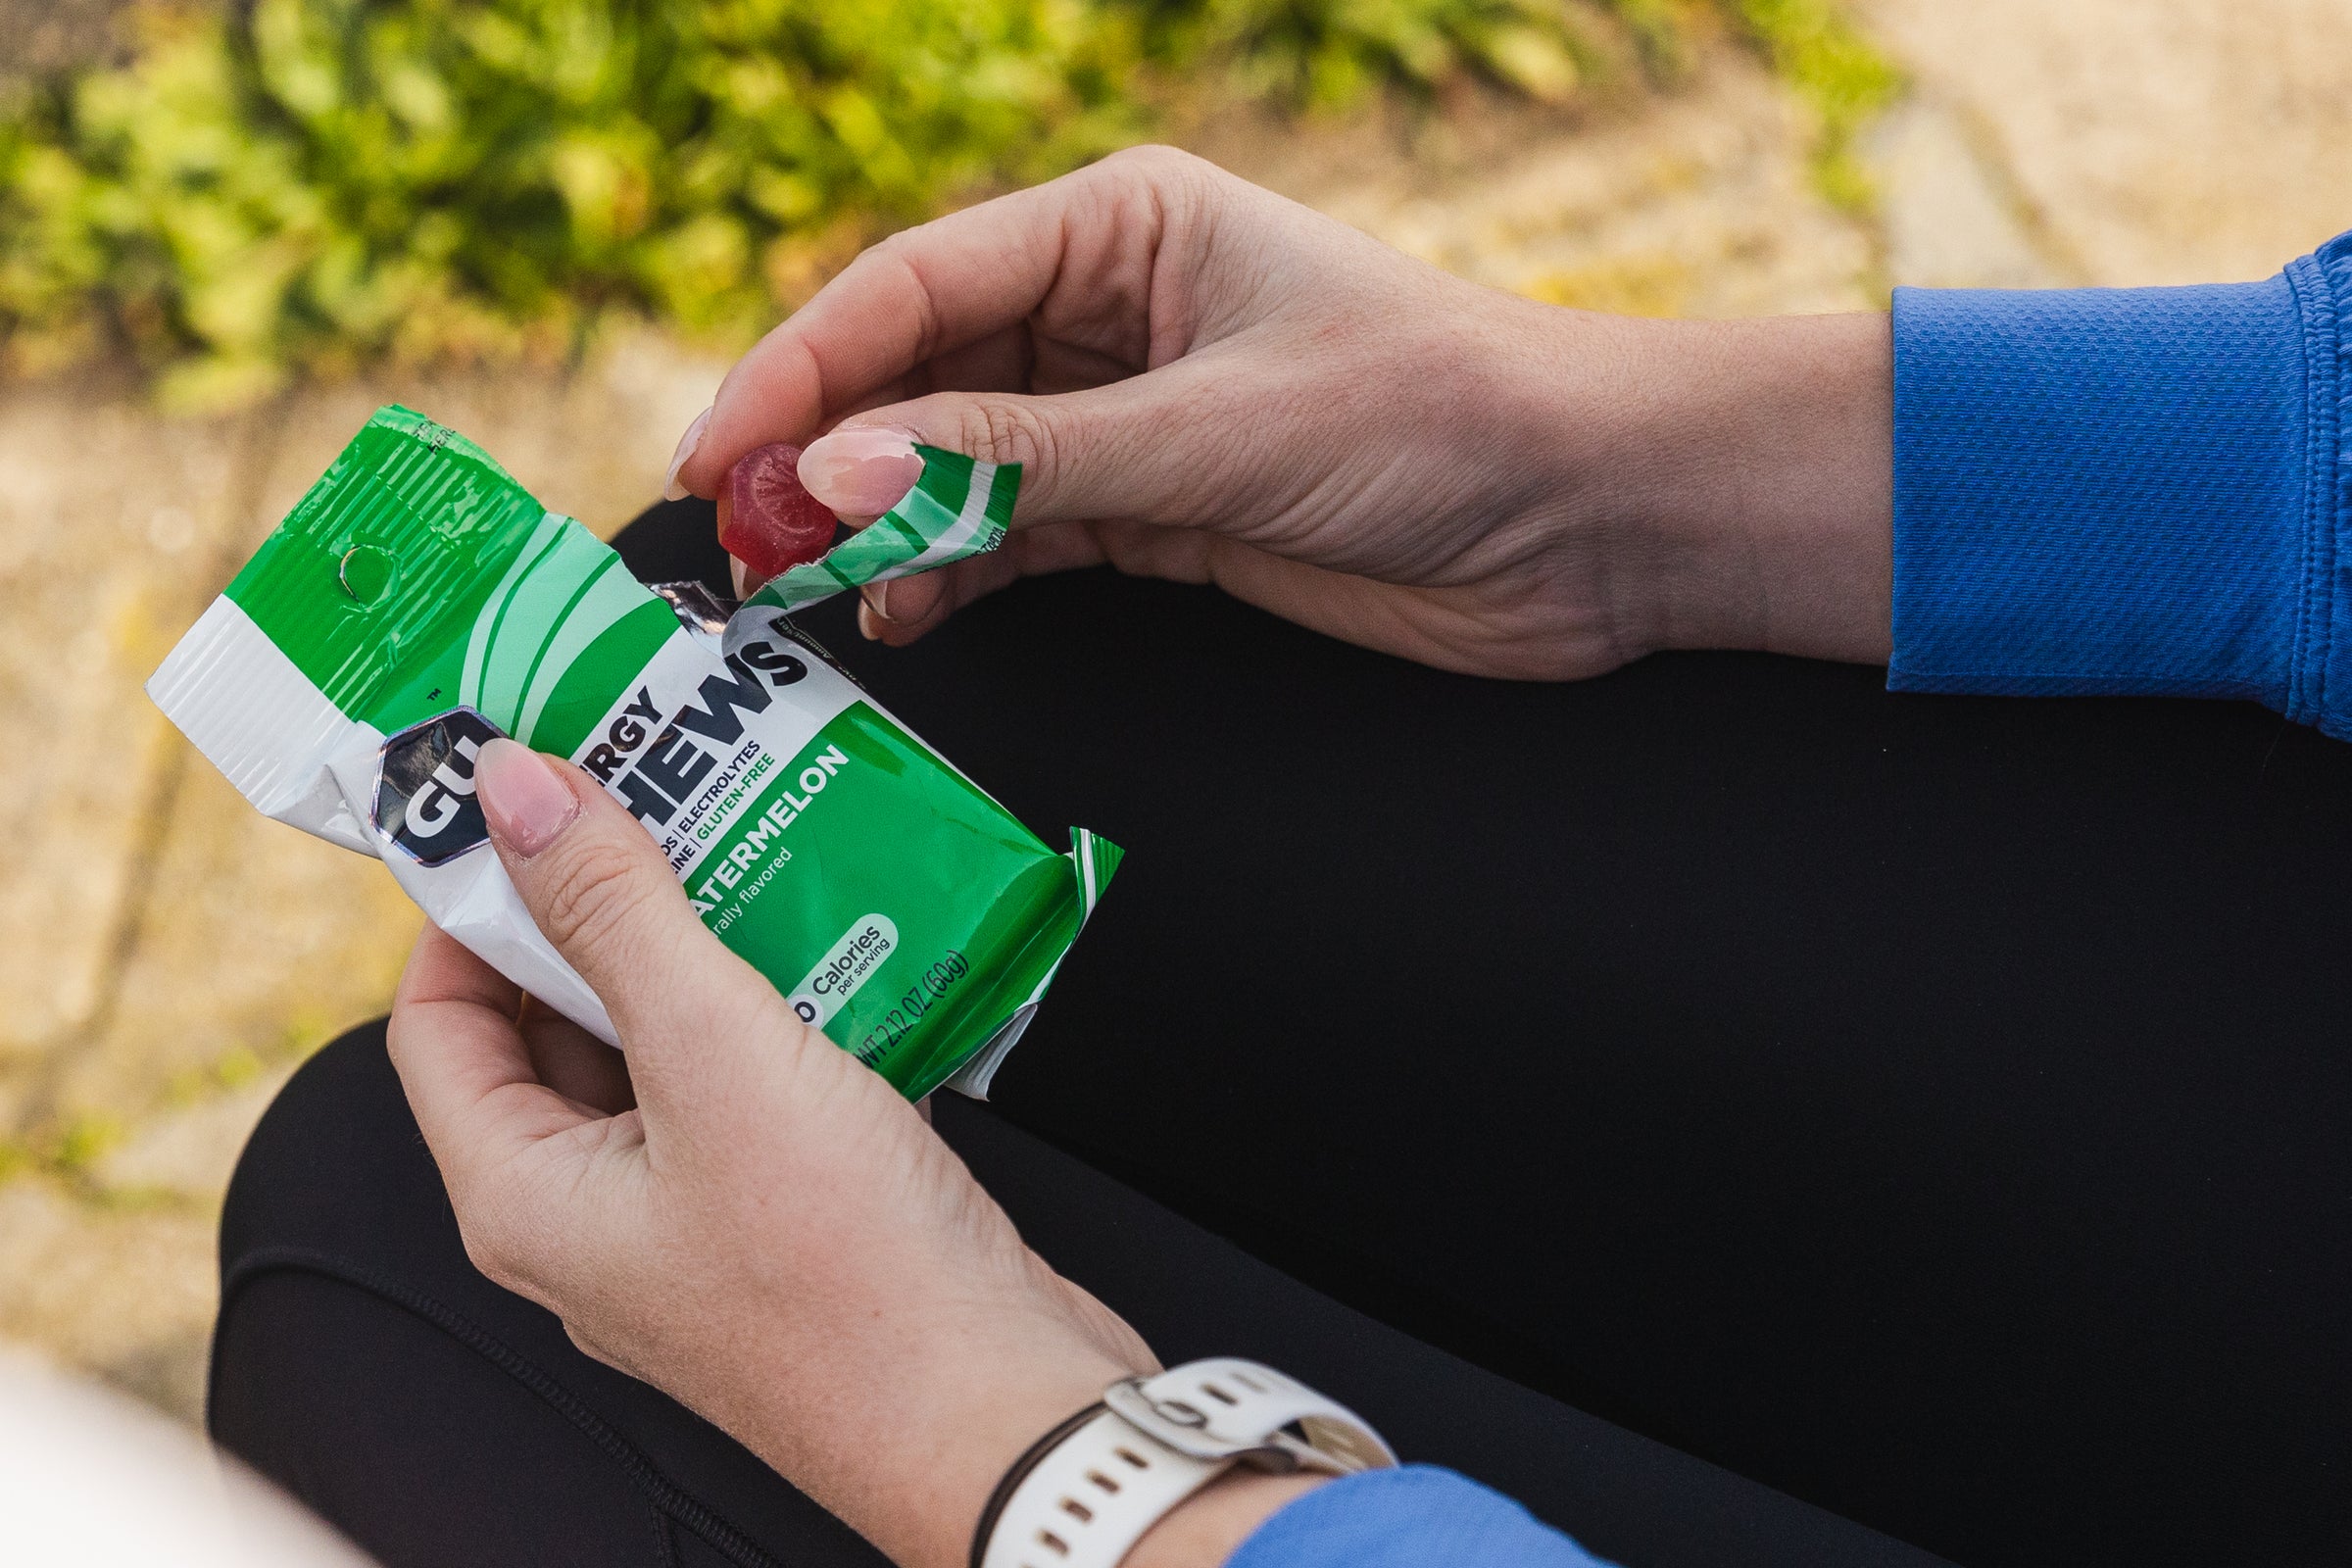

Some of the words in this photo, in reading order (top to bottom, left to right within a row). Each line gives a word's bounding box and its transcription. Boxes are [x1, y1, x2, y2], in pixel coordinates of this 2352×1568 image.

[578, 685, 663, 788] RGY
[616, 642, 808, 827] HEWS
[406, 736, 480, 838] GU
[678, 740, 760, 833] ELECTROLYTES
[688, 744, 850, 917] ATERMELON
[697, 753, 775, 841] GLUTEN-FREE
[712, 903, 744, 936] rally
[739, 847, 793, 904] flavored
[794, 1001, 816, 1023] 0
[812, 926, 880, 995] Calories
[837, 975, 855, 996] per
[855, 939, 891, 976] serving
[854, 1034, 887, 1069] WT
[875, 1009, 912, 1047] 2.12
[902, 987, 933, 1018] OZ
[922, 950, 969, 999] (60g)
